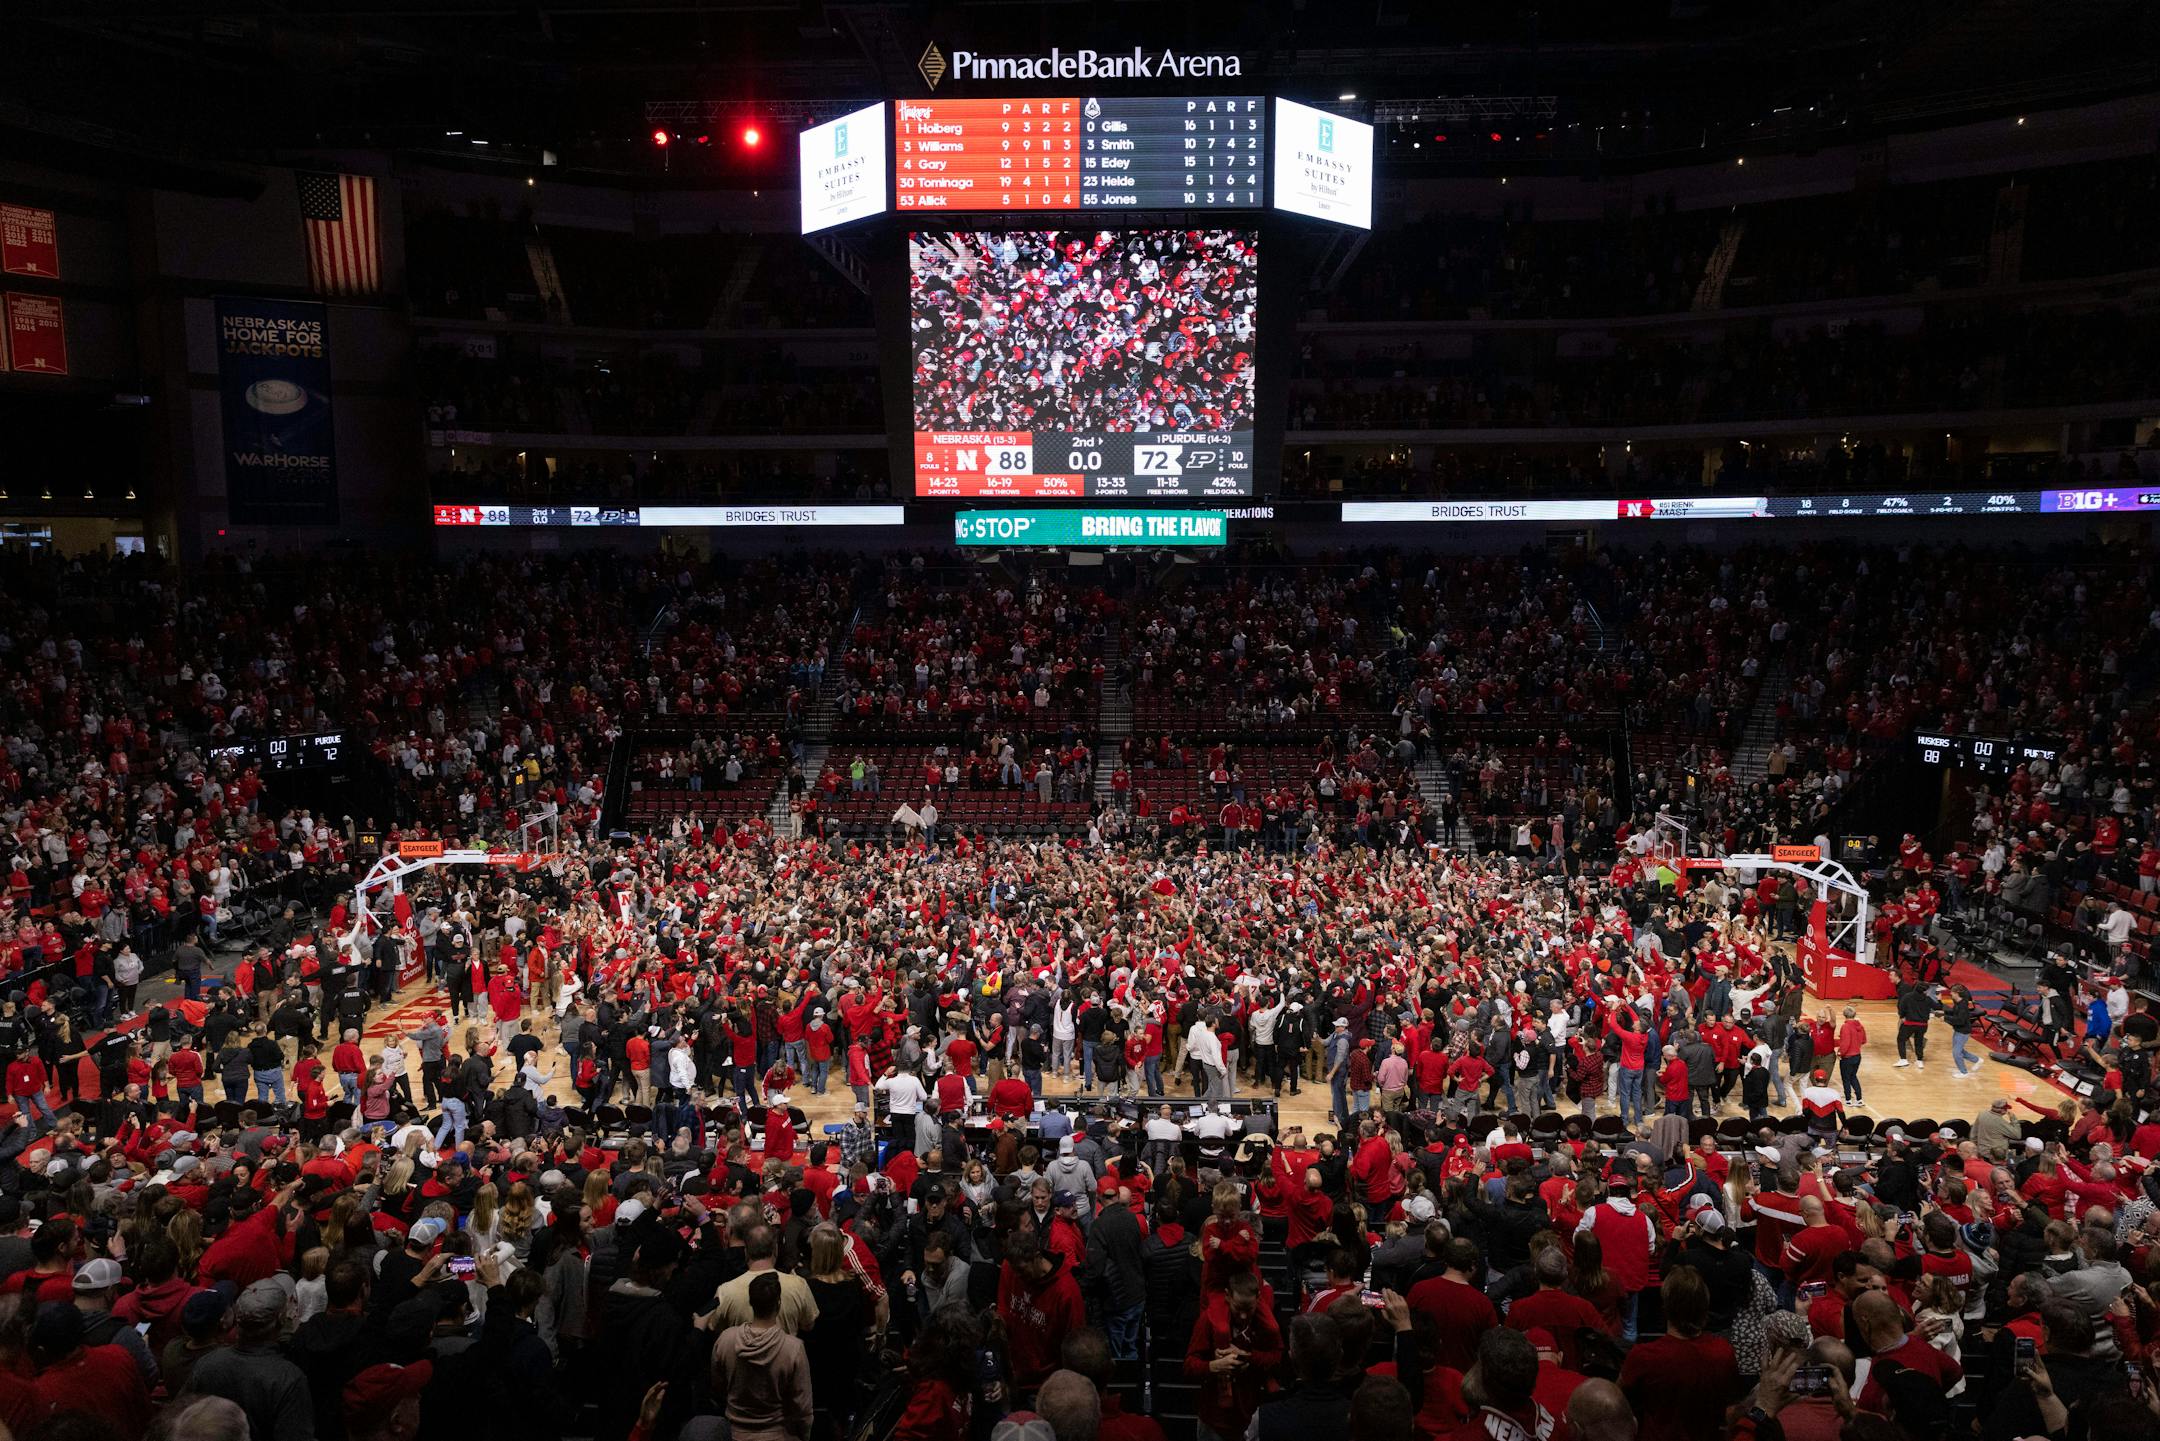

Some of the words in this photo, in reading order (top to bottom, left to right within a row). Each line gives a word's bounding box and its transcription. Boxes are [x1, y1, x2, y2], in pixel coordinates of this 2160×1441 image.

[953, 46, 1152, 79] PinnacleBank
[1156, 48, 1242, 77] Arena
[1003, 103, 1011, 114] P
[1022, 103, 1031, 114] A
[1042, 103, 1051, 114] R
[1062, 103, 1070, 114] F
[1187, 102, 1196, 112] P
[1206, 102, 1216, 112] A
[1227, 102, 1236, 112] R
[1248, 100, 1256, 112] F
[905, 124, 910, 134] 1
[1002, 122, 1009, 132] 9
[1023, 122, 1031, 132] 3
[1043, 122, 1050, 132] 2
[1063, 122, 1071, 132] 2
[1086, 121, 1095, 132] 0
[1184, 120, 1196, 130] 16
[1210, 120, 1214, 130] 1
[1229, 120, 1234, 130] 1
[1249, 120, 1256, 130] 3
[904, 141, 911, 152] 3
[1002, 140, 1010, 150] 9
[1023, 140, 1030, 150] 9
[1043, 140, 1051, 150] 11
[1063, 140, 1071, 150] 3
[1087, 140, 1094, 150] 3
[1102, 139, 1134, 150] Smith
[1184, 138, 1196, 149] 10
[1208, 138, 1215, 149] 7
[1227, 138, 1235, 149] 4
[1248, 138, 1256, 149] 2
[818, 156, 866, 178] EMBASSY
[904, 160, 912, 170] 4
[918, 160, 947, 171] Gary
[1001, 158, 1012, 168] 12
[1025, 158, 1029, 168] 1
[1042, 158, 1050, 168] 5
[1063, 158, 1071, 168] 2
[1085, 158, 1096, 168] 15
[1102, 158, 1130, 170] Edey
[1184, 156, 1196, 167] 15
[1209, 156, 1214, 167] 1
[1227, 156, 1235, 167] 7
[1248, 156, 1256, 167] 3
[1298, 152, 1352, 172] EMBASSY
[824, 172, 860, 190] SUITES
[900, 178, 914, 188] 30
[918, 178, 974, 190] Tominaga
[1000, 176, 1012, 187] 19
[1023, 176, 1031, 187] 4
[1044, 176, 1049, 187] 1
[1065, 176, 1069, 187] 1
[1084, 176, 1098, 187] 23
[1186, 175, 1194, 185] 5
[1209, 175, 1213, 185] 1
[1227, 175, 1234, 185] 6
[1247, 175, 1256, 185] 4
[1304, 168, 1345, 186] SUITES
[900, 195, 914, 206] 53
[1002, 194, 1010, 205] 5
[1025, 194, 1029, 205] 1
[1043, 194, 1050, 205] 0
[1063, 194, 1071, 205] 4
[1084, 194, 1098, 205] 55
[1102, 194, 1137, 205] Jones
[1184, 192, 1196, 203] 10
[1207, 192, 1214, 203] 3
[1226, 192, 1234, 203] 4
[1249, 192, 1254, 203] 1
[223, 316, 321, 332] NEBRASKA'S
[224, 328, 280, 342] HOME
[286, 330, 321, 345] FOR
[226, 341, 322, 358] JACKPOTS
[933, 434, 992, 444] NEBRASKA
[1072, 437, 1094, 447] 2nd
[1162, 434, 1206, 444] PURDUE
[1208, 436, 1231, 444] (14-2)
[926, 452, 934, 462] 8
[956, 450, 978, 471] N
[1000, 451, 1026, 470] 88
[1068, 452, 1102, 470] 0.0
[1142, 452, 1168, 469] 72
[1232, 452, 1243, 461] 10
[929, 478, 958, 487] 14-23
[987, 478, 1012, 487] 16-19
[1044, 478, 1067, 487] 50%
[1097, 478, 1125, 487] 13-33
[1157, 478, 1179, 487] 11-15
[1212, 478, 1236, 487] 42%
[1801, 500, 1811, 508] 18
[1842, 499, 1849, 507] 8
[1883, 498, 1908, 507] 47%
[1943, 496, 1952, 506] 2
[1988, 495, 2015, 504] 40%
[460, 509, 475, 522] N
[1432, 506, 1483, 517] BRIDGES
[1627, 503, 1642, 516] N
[488, 510, 506, 522] 88
[533, 516, 548, 524] 0.0
[574, 511, 592, 522] 72
[726, 511, 775, 522] BRIDGES
[1082, 516, 1143, 536] BRING
[1147, 517, 1178, 536] THE
[315, 735, 341, 745] PURDUE
[1918, 736, 1950, 748] HUSKERS
[324, 748, 337, 760] 72
[1924, 750, 1940, 763] 88
[1778, 849, 1815, 857] SEATGEEK
